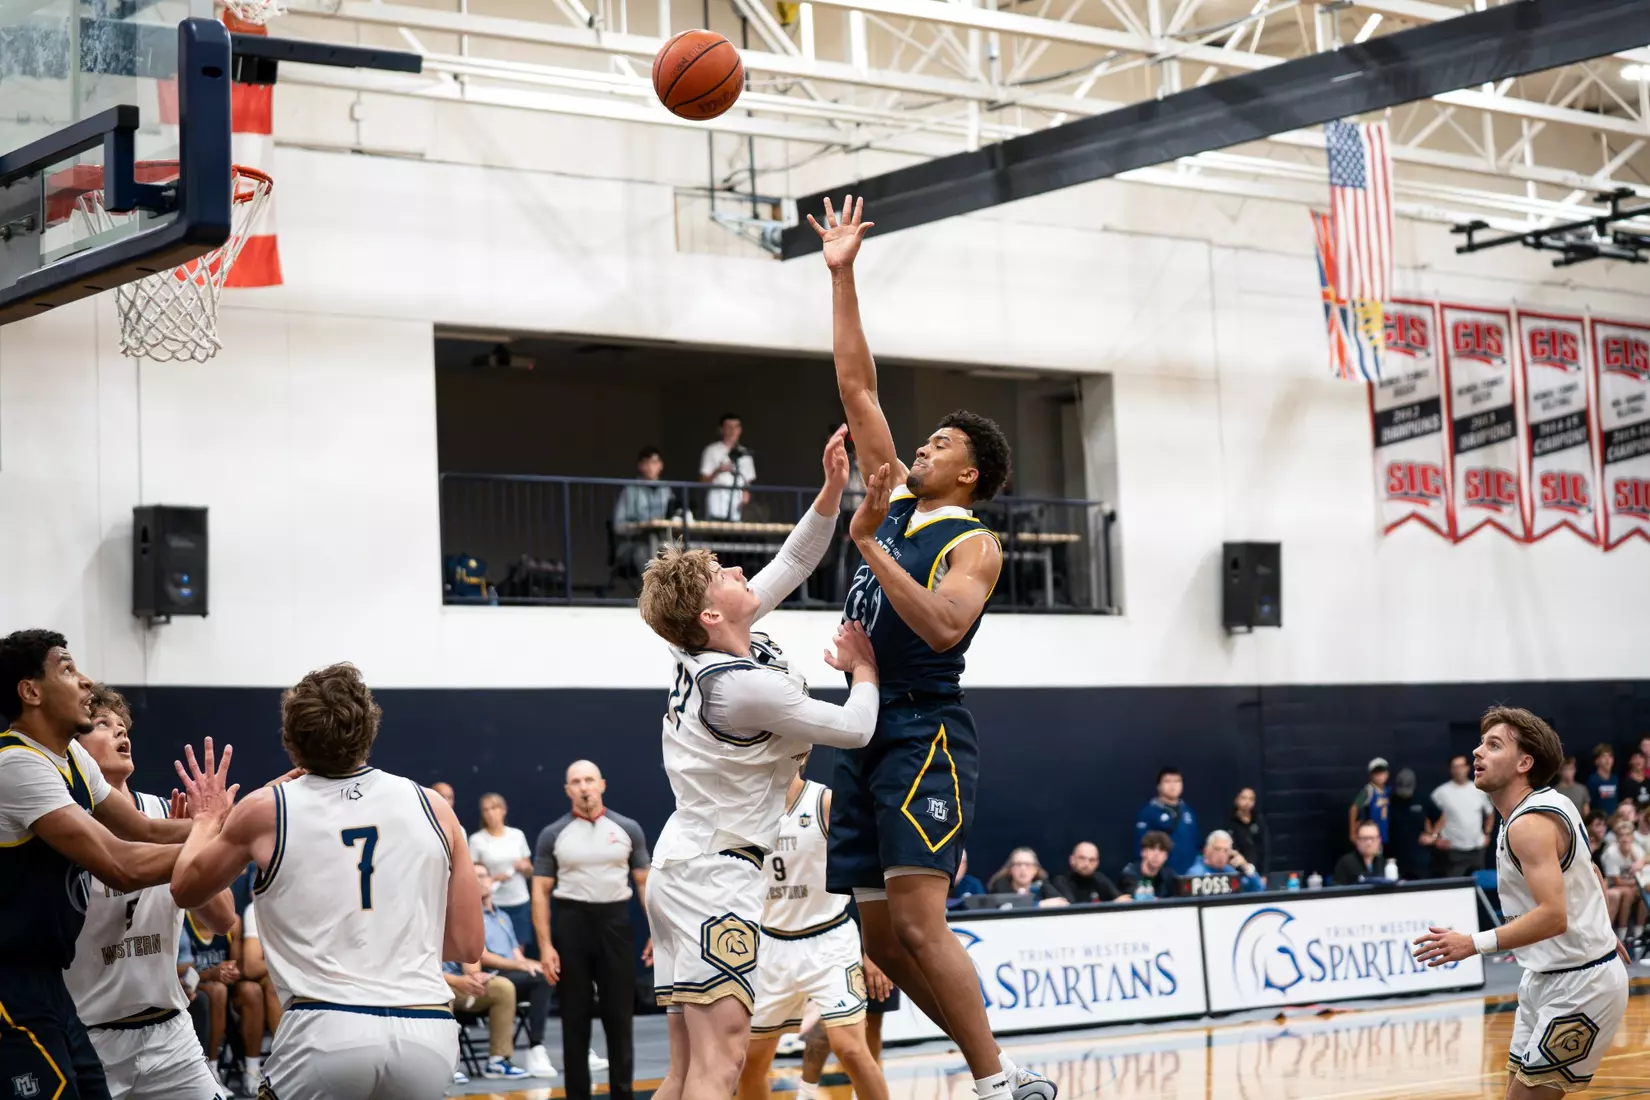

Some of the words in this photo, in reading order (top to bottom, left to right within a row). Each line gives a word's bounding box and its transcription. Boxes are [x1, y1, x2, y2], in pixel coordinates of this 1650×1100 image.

[1452, 320, 1503, 356] CIS
[1529, 328, 1579, 362] CIS
[1603, 336, 1649, 371] CIS
[1387, 462, 1441, 498] SIC
[1465, 468, 1515, 504] SIC
[1540, 471, 1588, 506] SIC
[926, 797, 949, 823] MU
[340, 824, 380, 912] 7
[772, 856, 787, 882] 9
[1326, 924, 1374, 937] TRINITY
[1019, 949, 1076, 962] TRINITY
[1084, 942, 1151, 957] WESTERN
[996, 949, 1178, 1013] SPARTANS
[11, 1072, 40, 1098] MU
